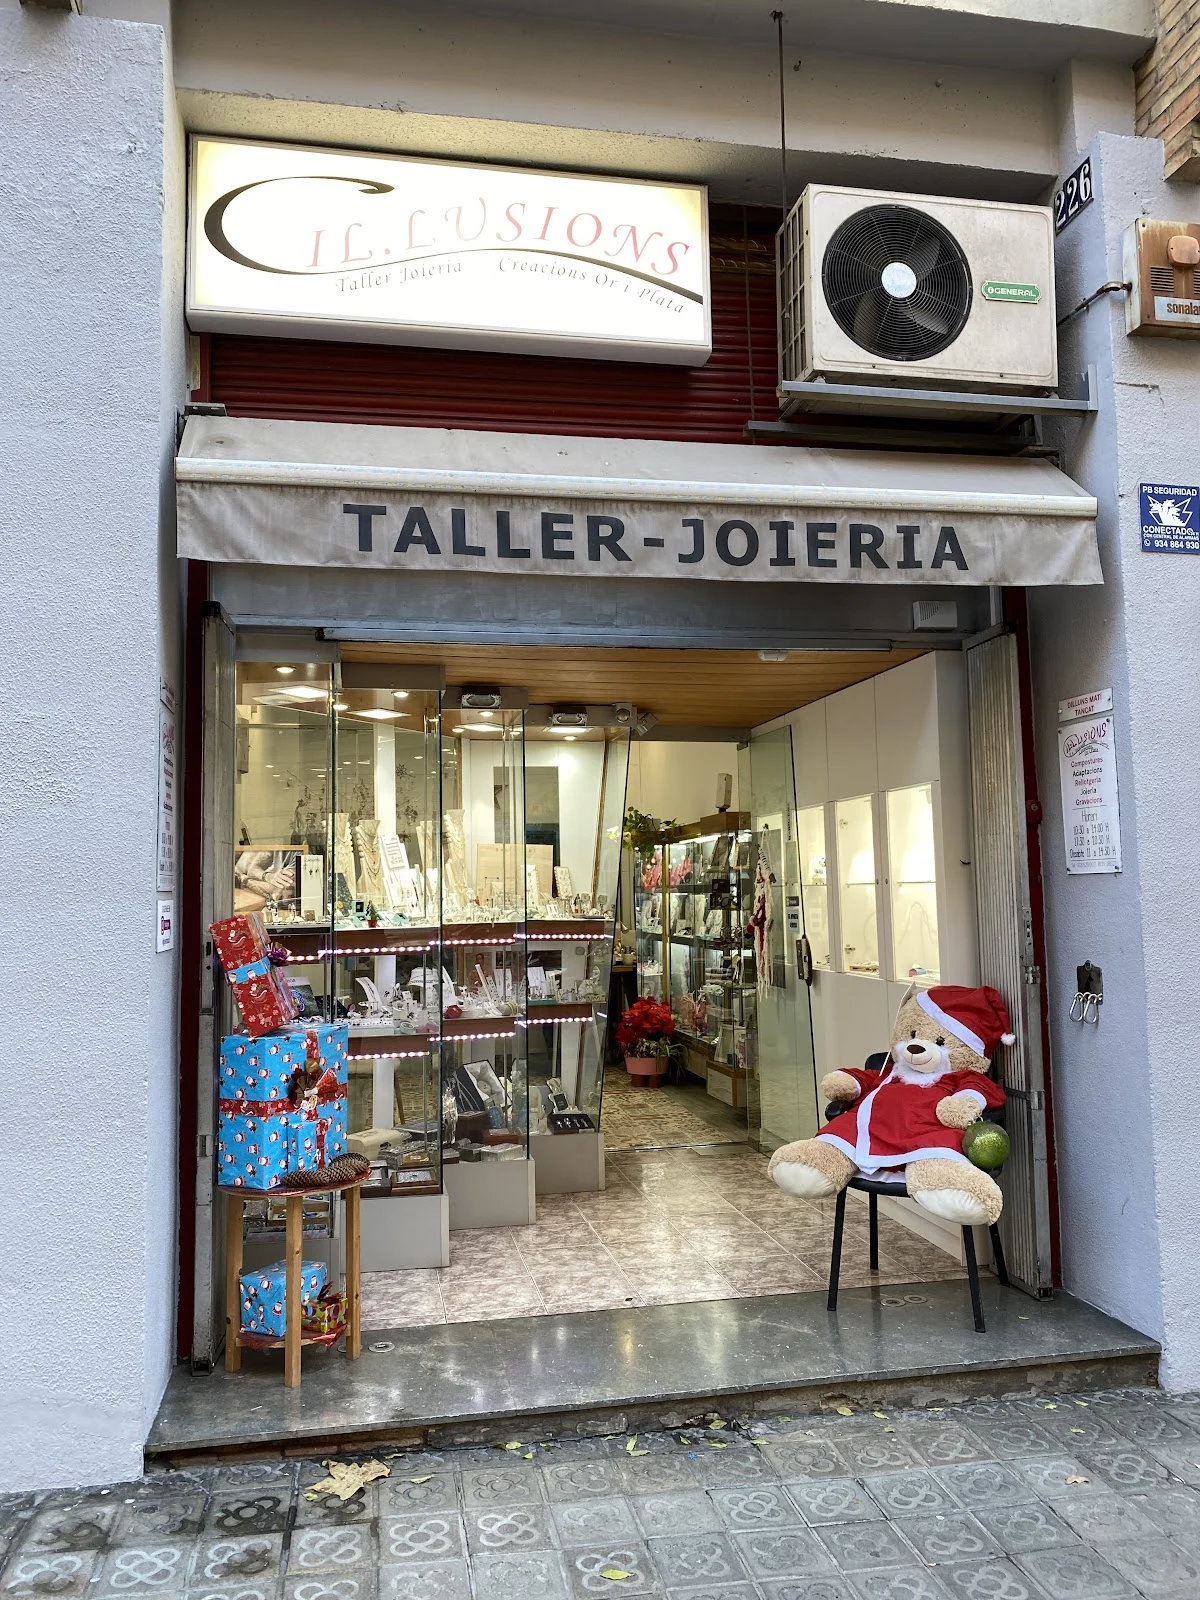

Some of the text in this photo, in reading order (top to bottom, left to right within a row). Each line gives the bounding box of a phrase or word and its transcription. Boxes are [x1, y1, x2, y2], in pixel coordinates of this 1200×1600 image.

[1055, 162, 1091, 225] 226
[336, 260, 462, 292] Taller Joieria
[499, 257, 588, 281] Creacions
[595, 272, 620, 286] Or
[637, 286, 685, 314] Plata
[1166, 302, 1200, 316] sonala
[1142, 486, 1198, 497] PB SEGURIDAD
[1143, 525, 1193, 535] CONECTADO
[343, 503, 969, 571] TALLER-JOIERIA
[1154, 539, 1200, 550] 934 864 930
[1067, 697, 1089, 709] DILLUNS
[1074, 705, 1095, 716] TANCAT
[1070, 757, 1103, 768] Compostures
[1072, 767, 1103, 778] Adaptacions
[1075, 797, 1103, 806] Gravacions
